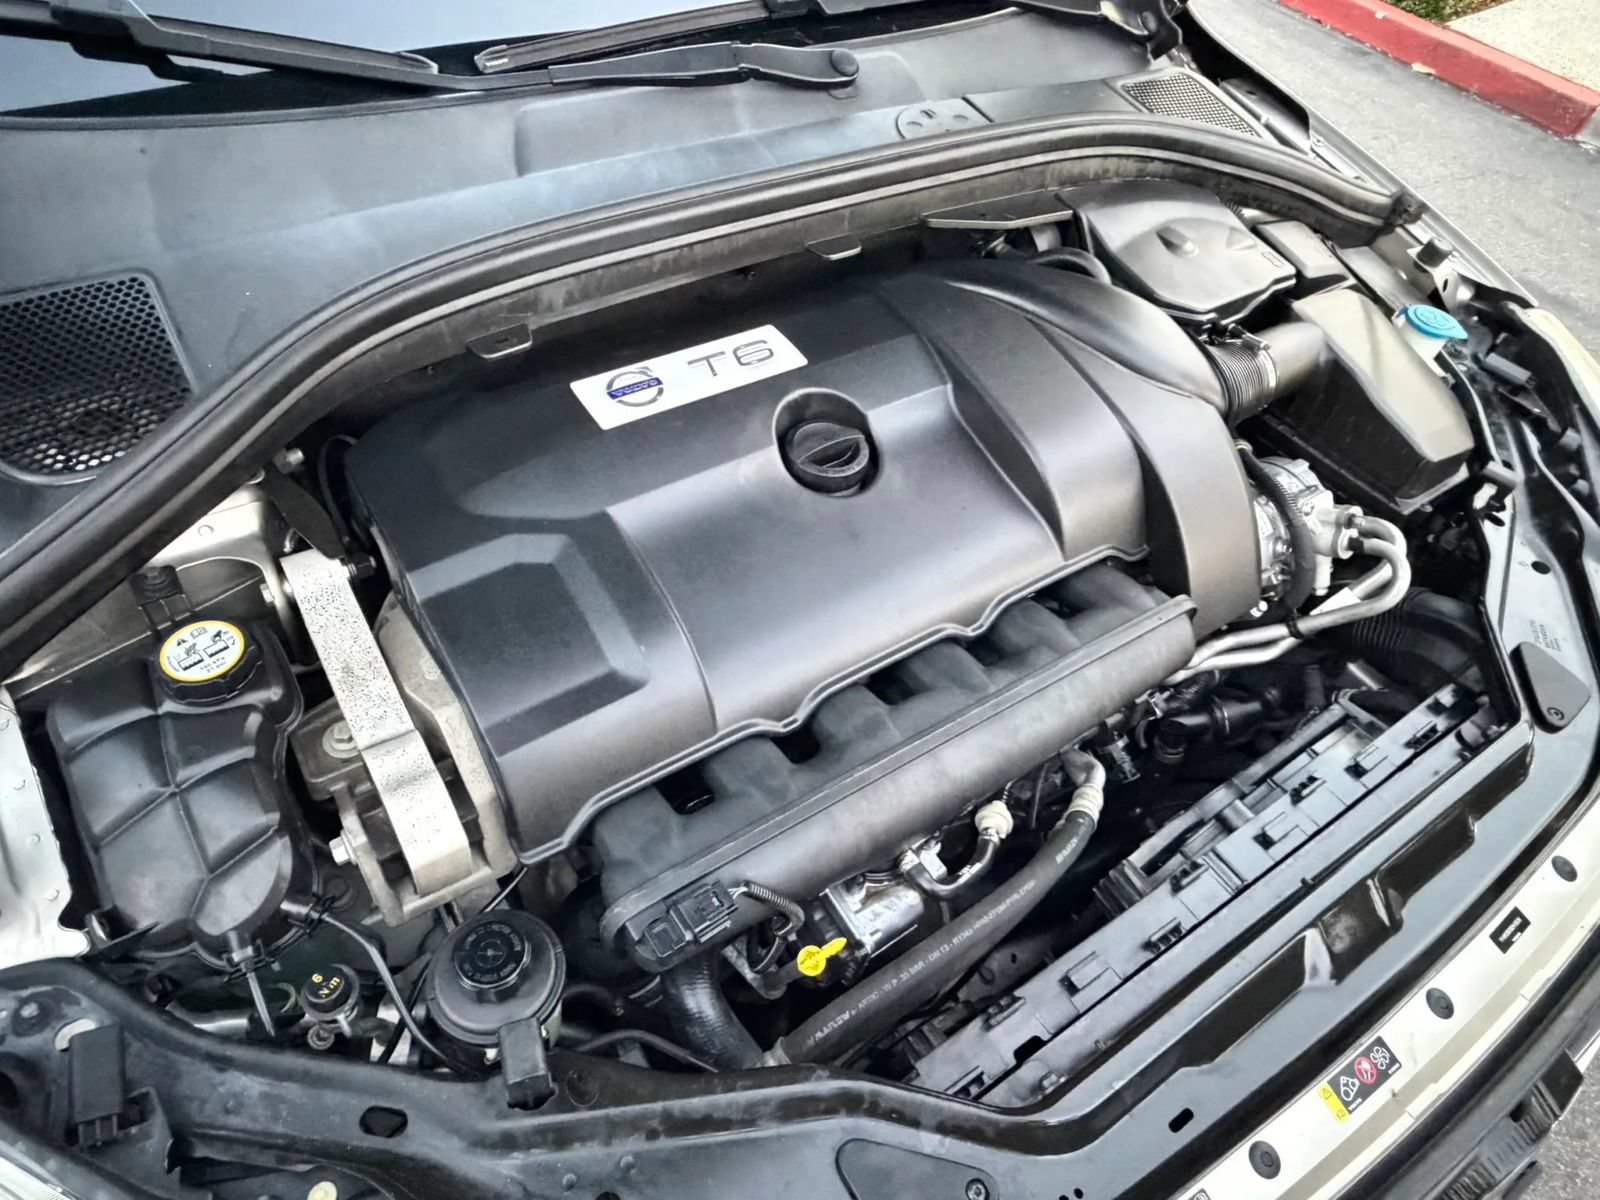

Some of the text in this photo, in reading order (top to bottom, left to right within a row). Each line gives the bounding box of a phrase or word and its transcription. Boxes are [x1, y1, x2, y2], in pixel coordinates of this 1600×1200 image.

[686, 339, 774, 377] T6
[610, 378, 660, 398] VOLVO
[940, 943, 950, 954] 13
[311, 973, 323, 983] 6
